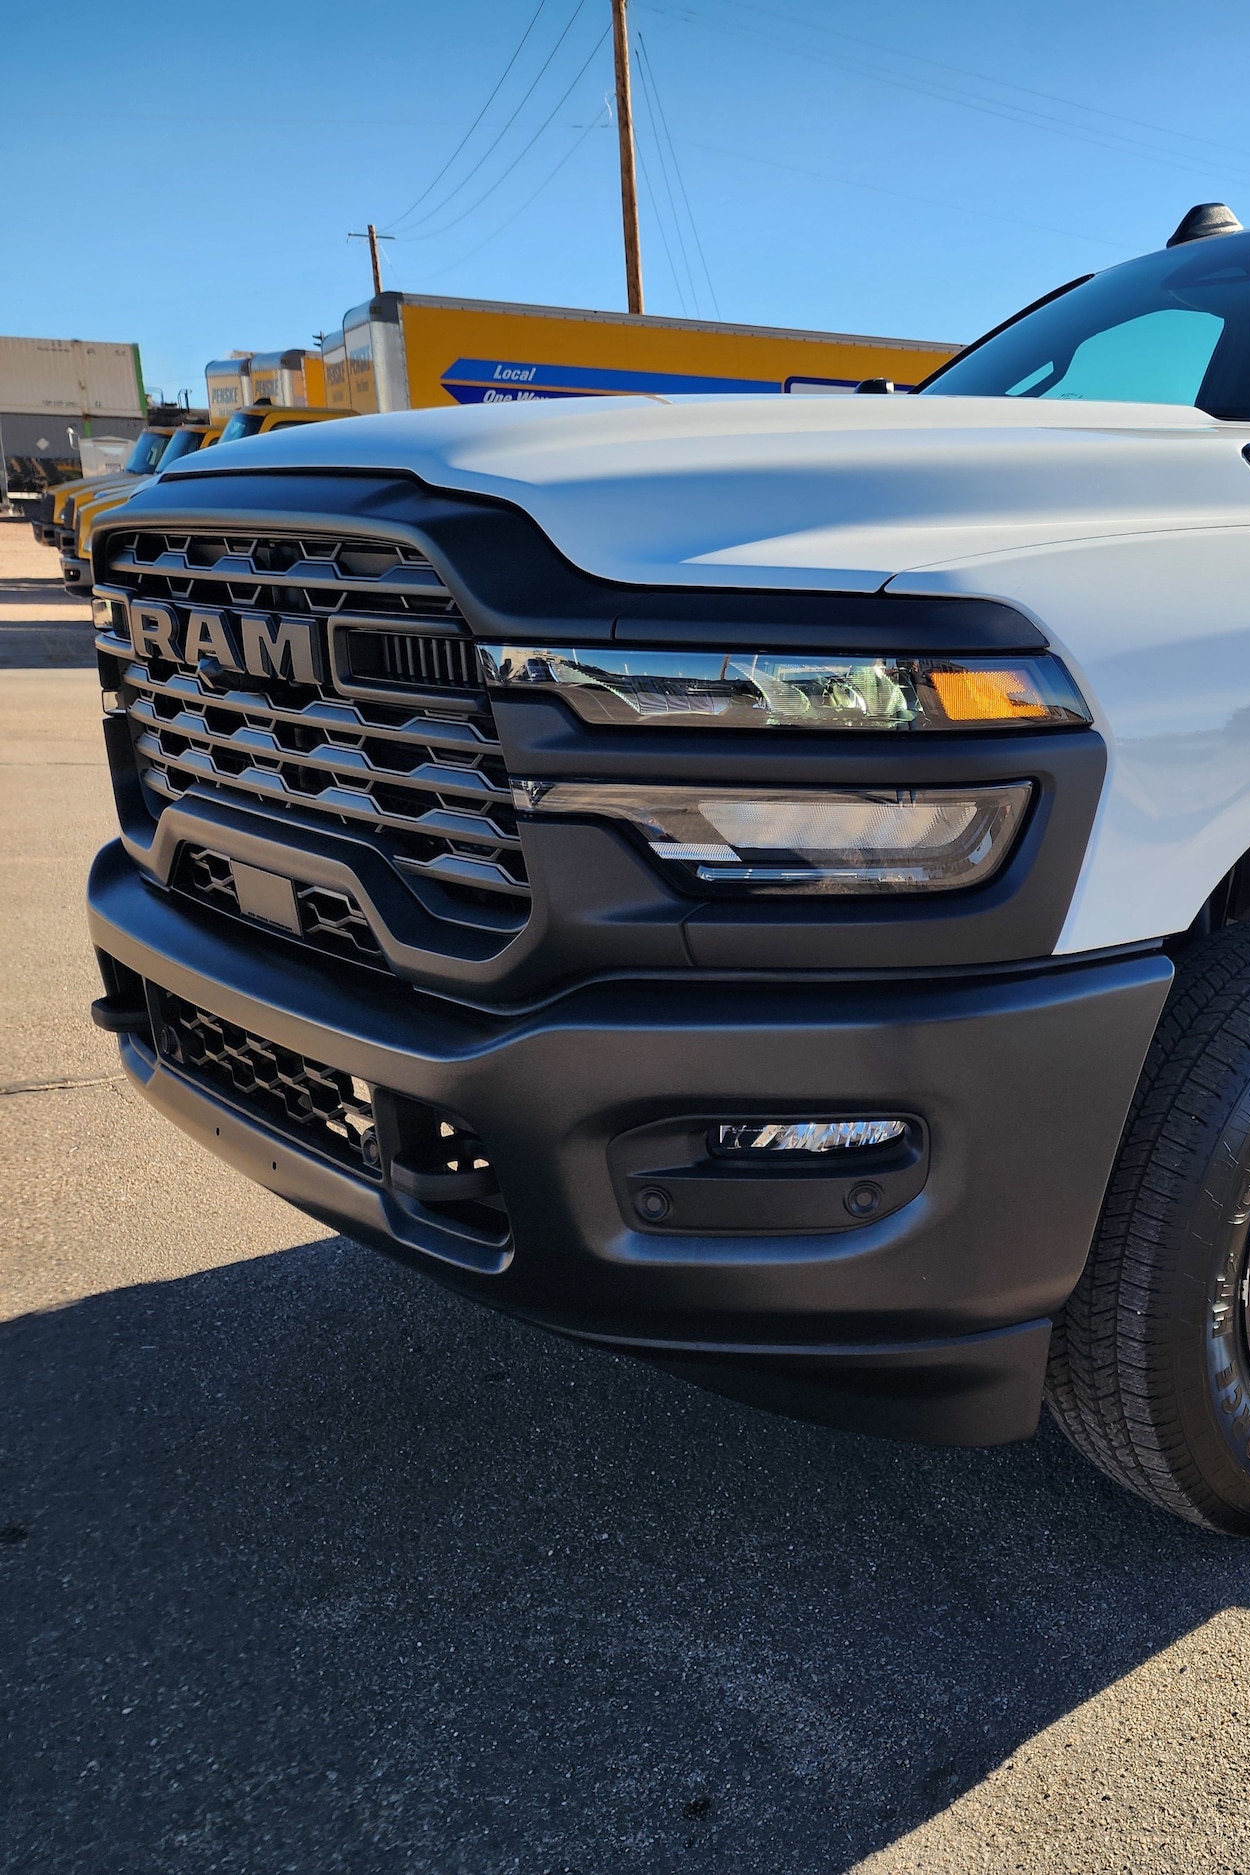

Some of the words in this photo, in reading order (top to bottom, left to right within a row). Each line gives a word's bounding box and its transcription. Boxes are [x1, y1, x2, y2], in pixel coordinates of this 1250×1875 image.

[493, 364, 537, 381] Local
[211, 386, 239, 404] PENSKE
[483, 389, 513, 404] One
[130, 599, 324, 686] RAM
